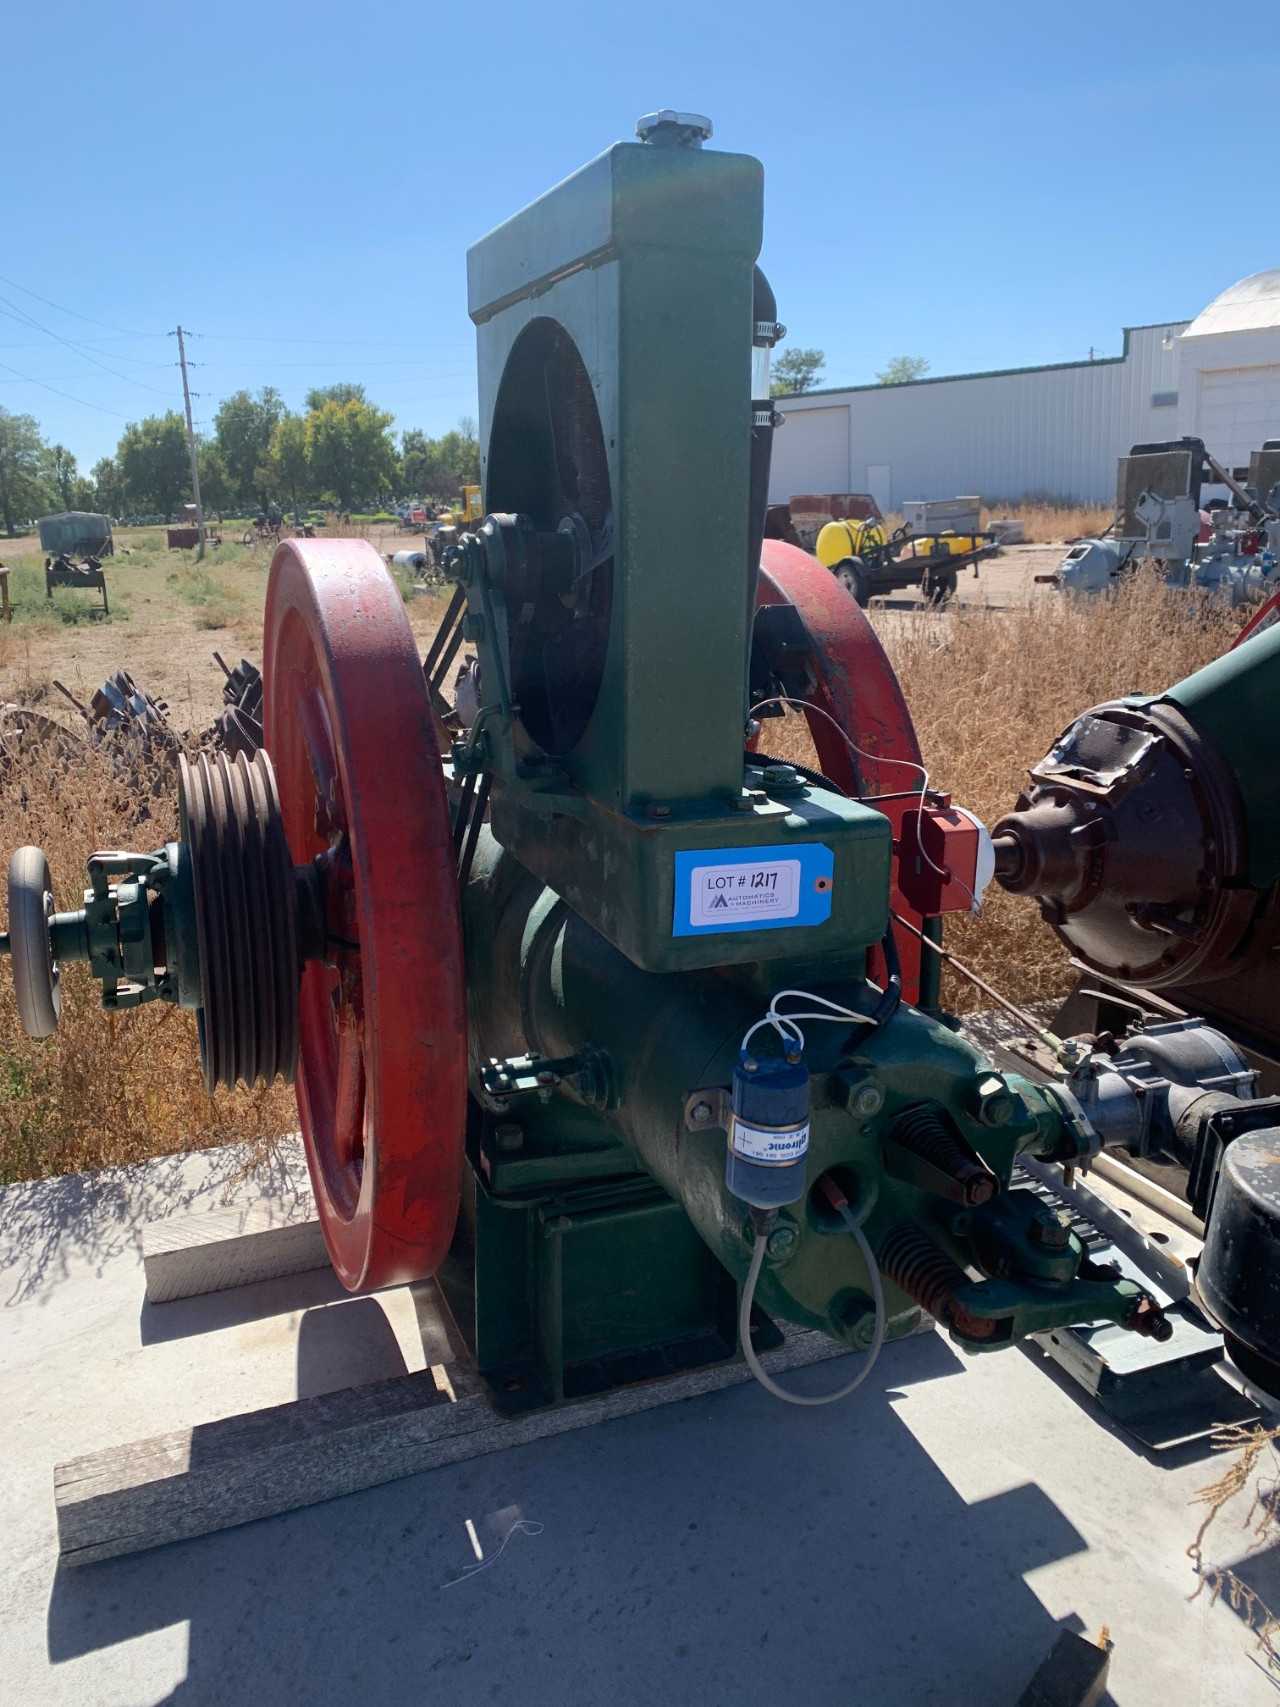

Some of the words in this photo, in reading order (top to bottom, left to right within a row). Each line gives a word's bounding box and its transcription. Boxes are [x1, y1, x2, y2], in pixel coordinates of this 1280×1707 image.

[707, 876, 735, 890] LOT
[738, 875, 746, 888] #
[750, 871, 778, 890] 1217
